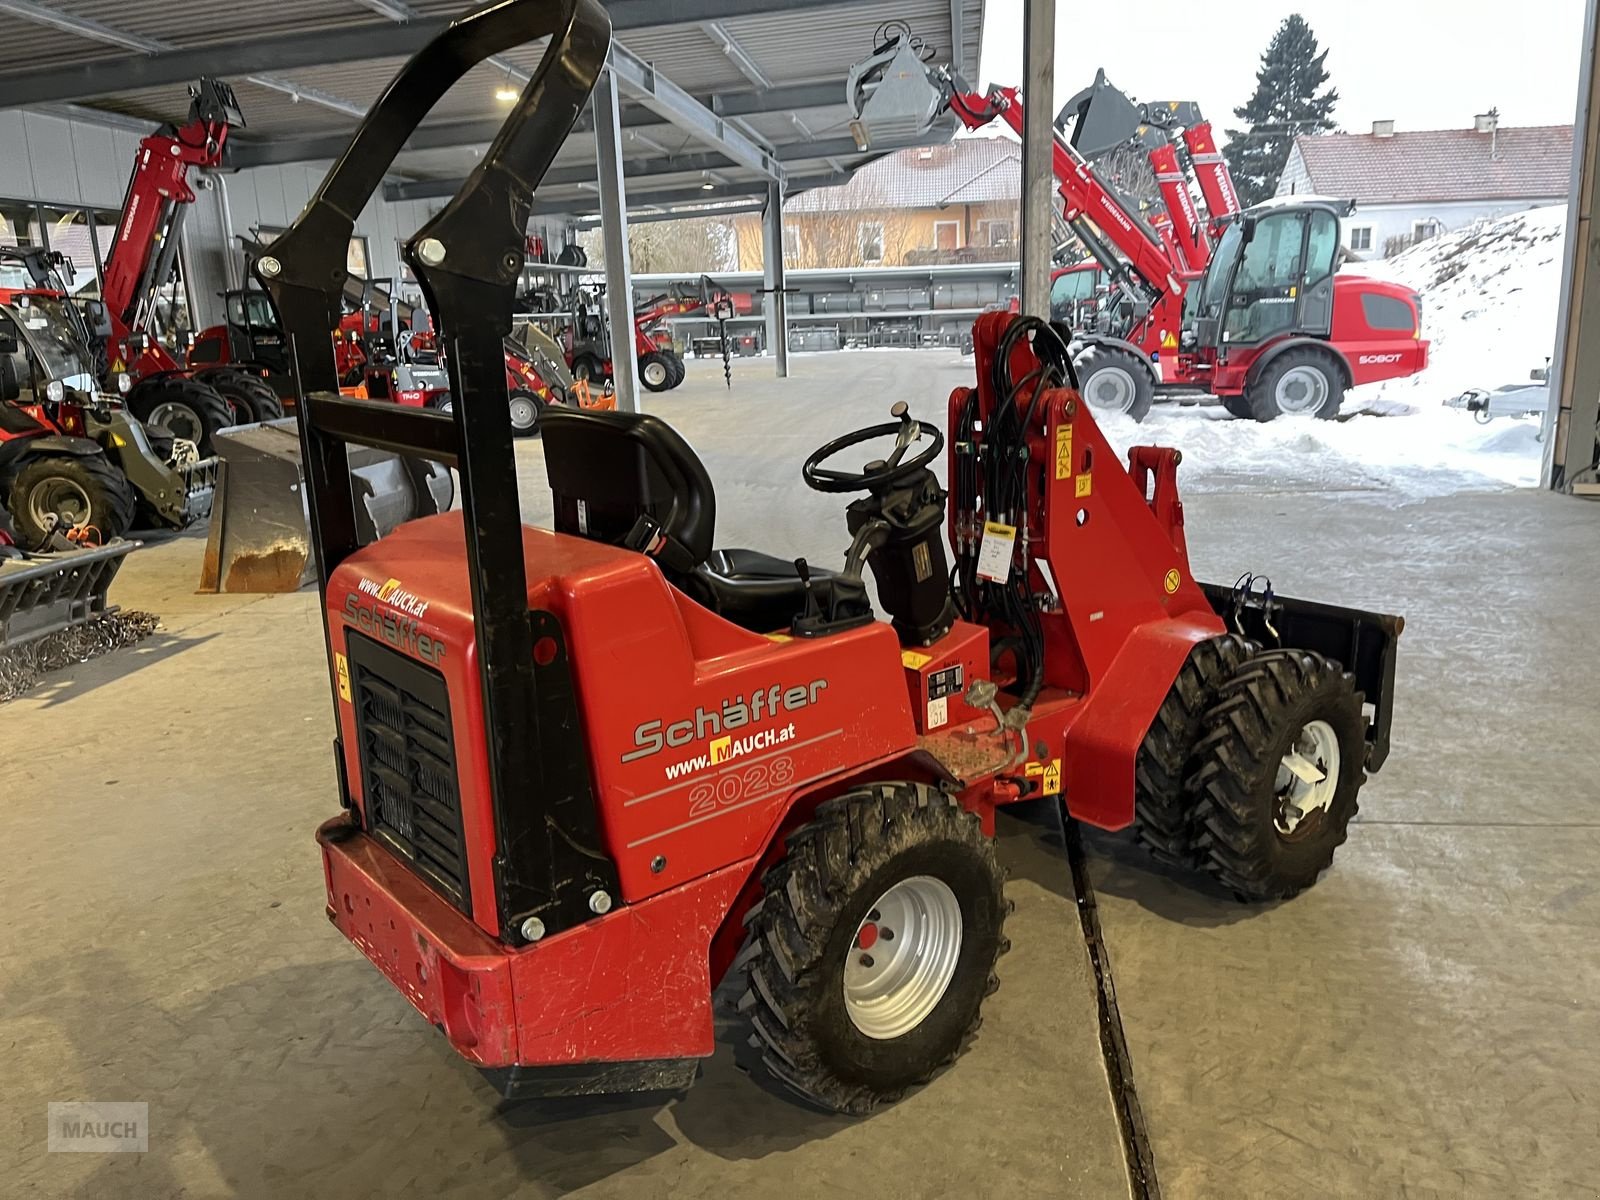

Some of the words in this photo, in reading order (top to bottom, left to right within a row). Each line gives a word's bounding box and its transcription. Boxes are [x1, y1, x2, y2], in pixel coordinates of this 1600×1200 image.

[1100, 195, 1132, 232] WEIDEMANN
[1175, 182, 1196, 228] WEIDEMA
[1213, 163, 1237, 214] WEIDEMA
[358, 577, 430, 618] www.MAUCH.at
[340, 592, 446, 665] Schäffer
[620, 678, 828, 763] Schäffer
[665, 722, 796, 780] www.MAUCH.at
[688, 756, 795, 817] 2028
